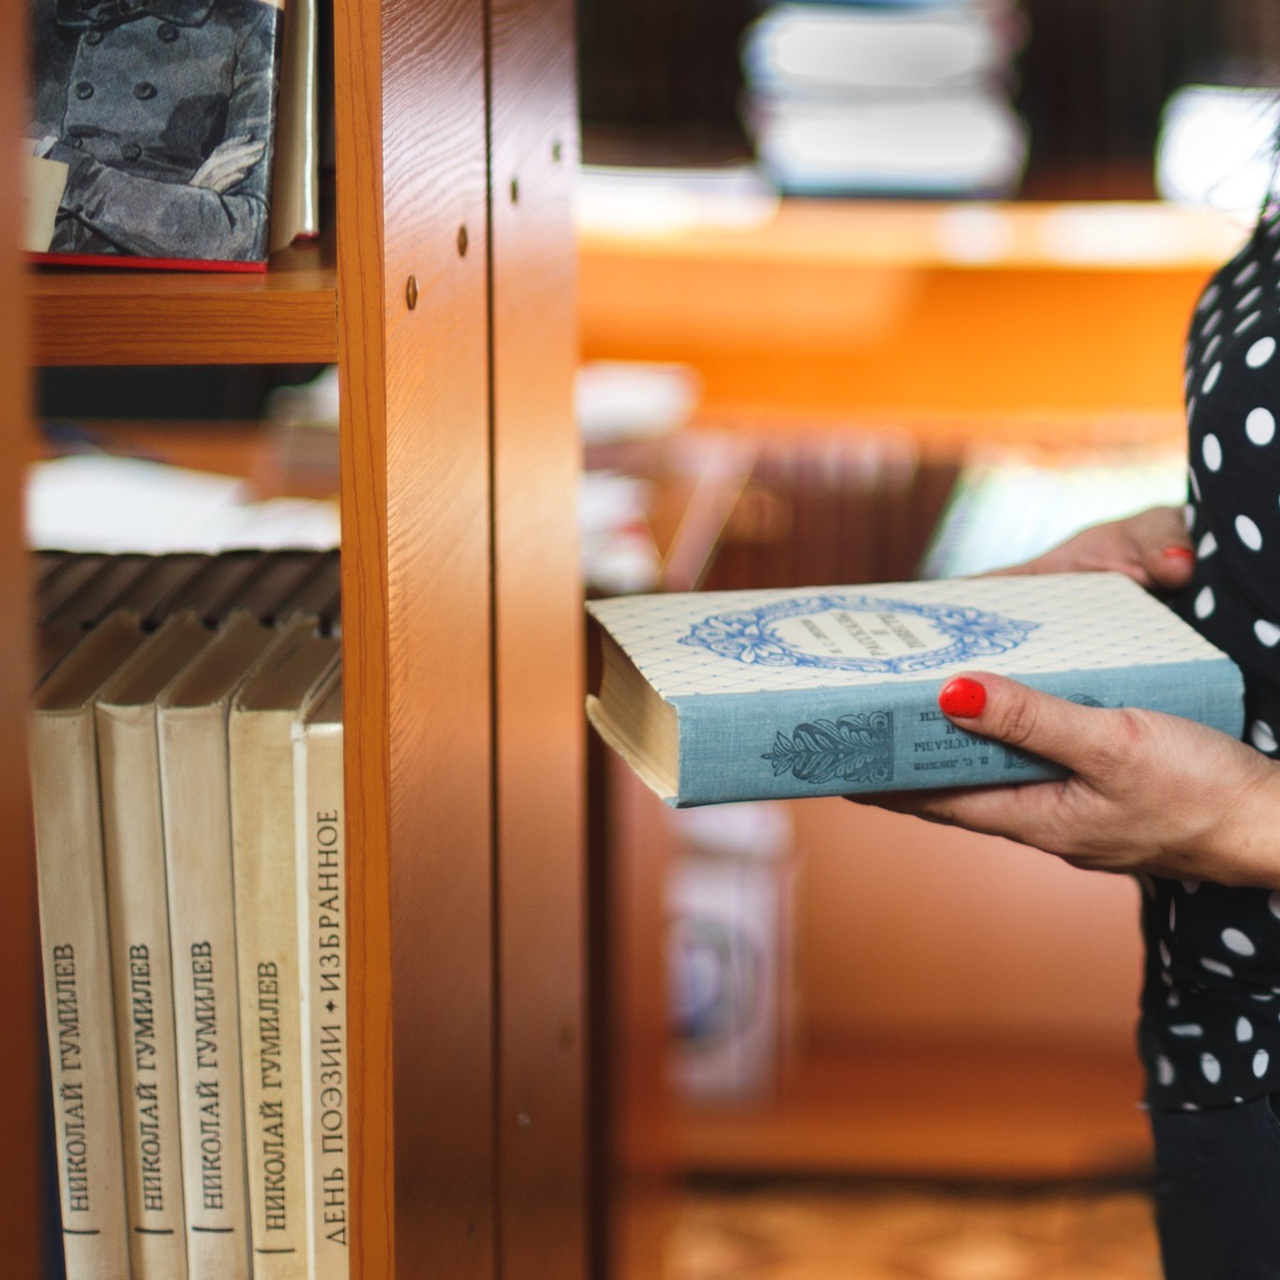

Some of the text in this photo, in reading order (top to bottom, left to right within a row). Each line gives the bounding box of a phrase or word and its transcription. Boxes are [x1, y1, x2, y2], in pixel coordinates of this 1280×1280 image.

[53, 943, 91, 1213] НИКОЛАЙ ГУМИЛЕВ
[129, 943, 165, 1213] НИКОЛАЙ ГУМИЛЕВ
[190, 940, 224, 1211] НИКОЛАЙ ГУМИЛЕВ
[256, 960, 286, 1233] НИКОЛАЙ ГУМИЛЕВ
[316, 808, 348, 1248] ДЕНЬ ПОЭЗИИ ИЗБРАННОЕ
